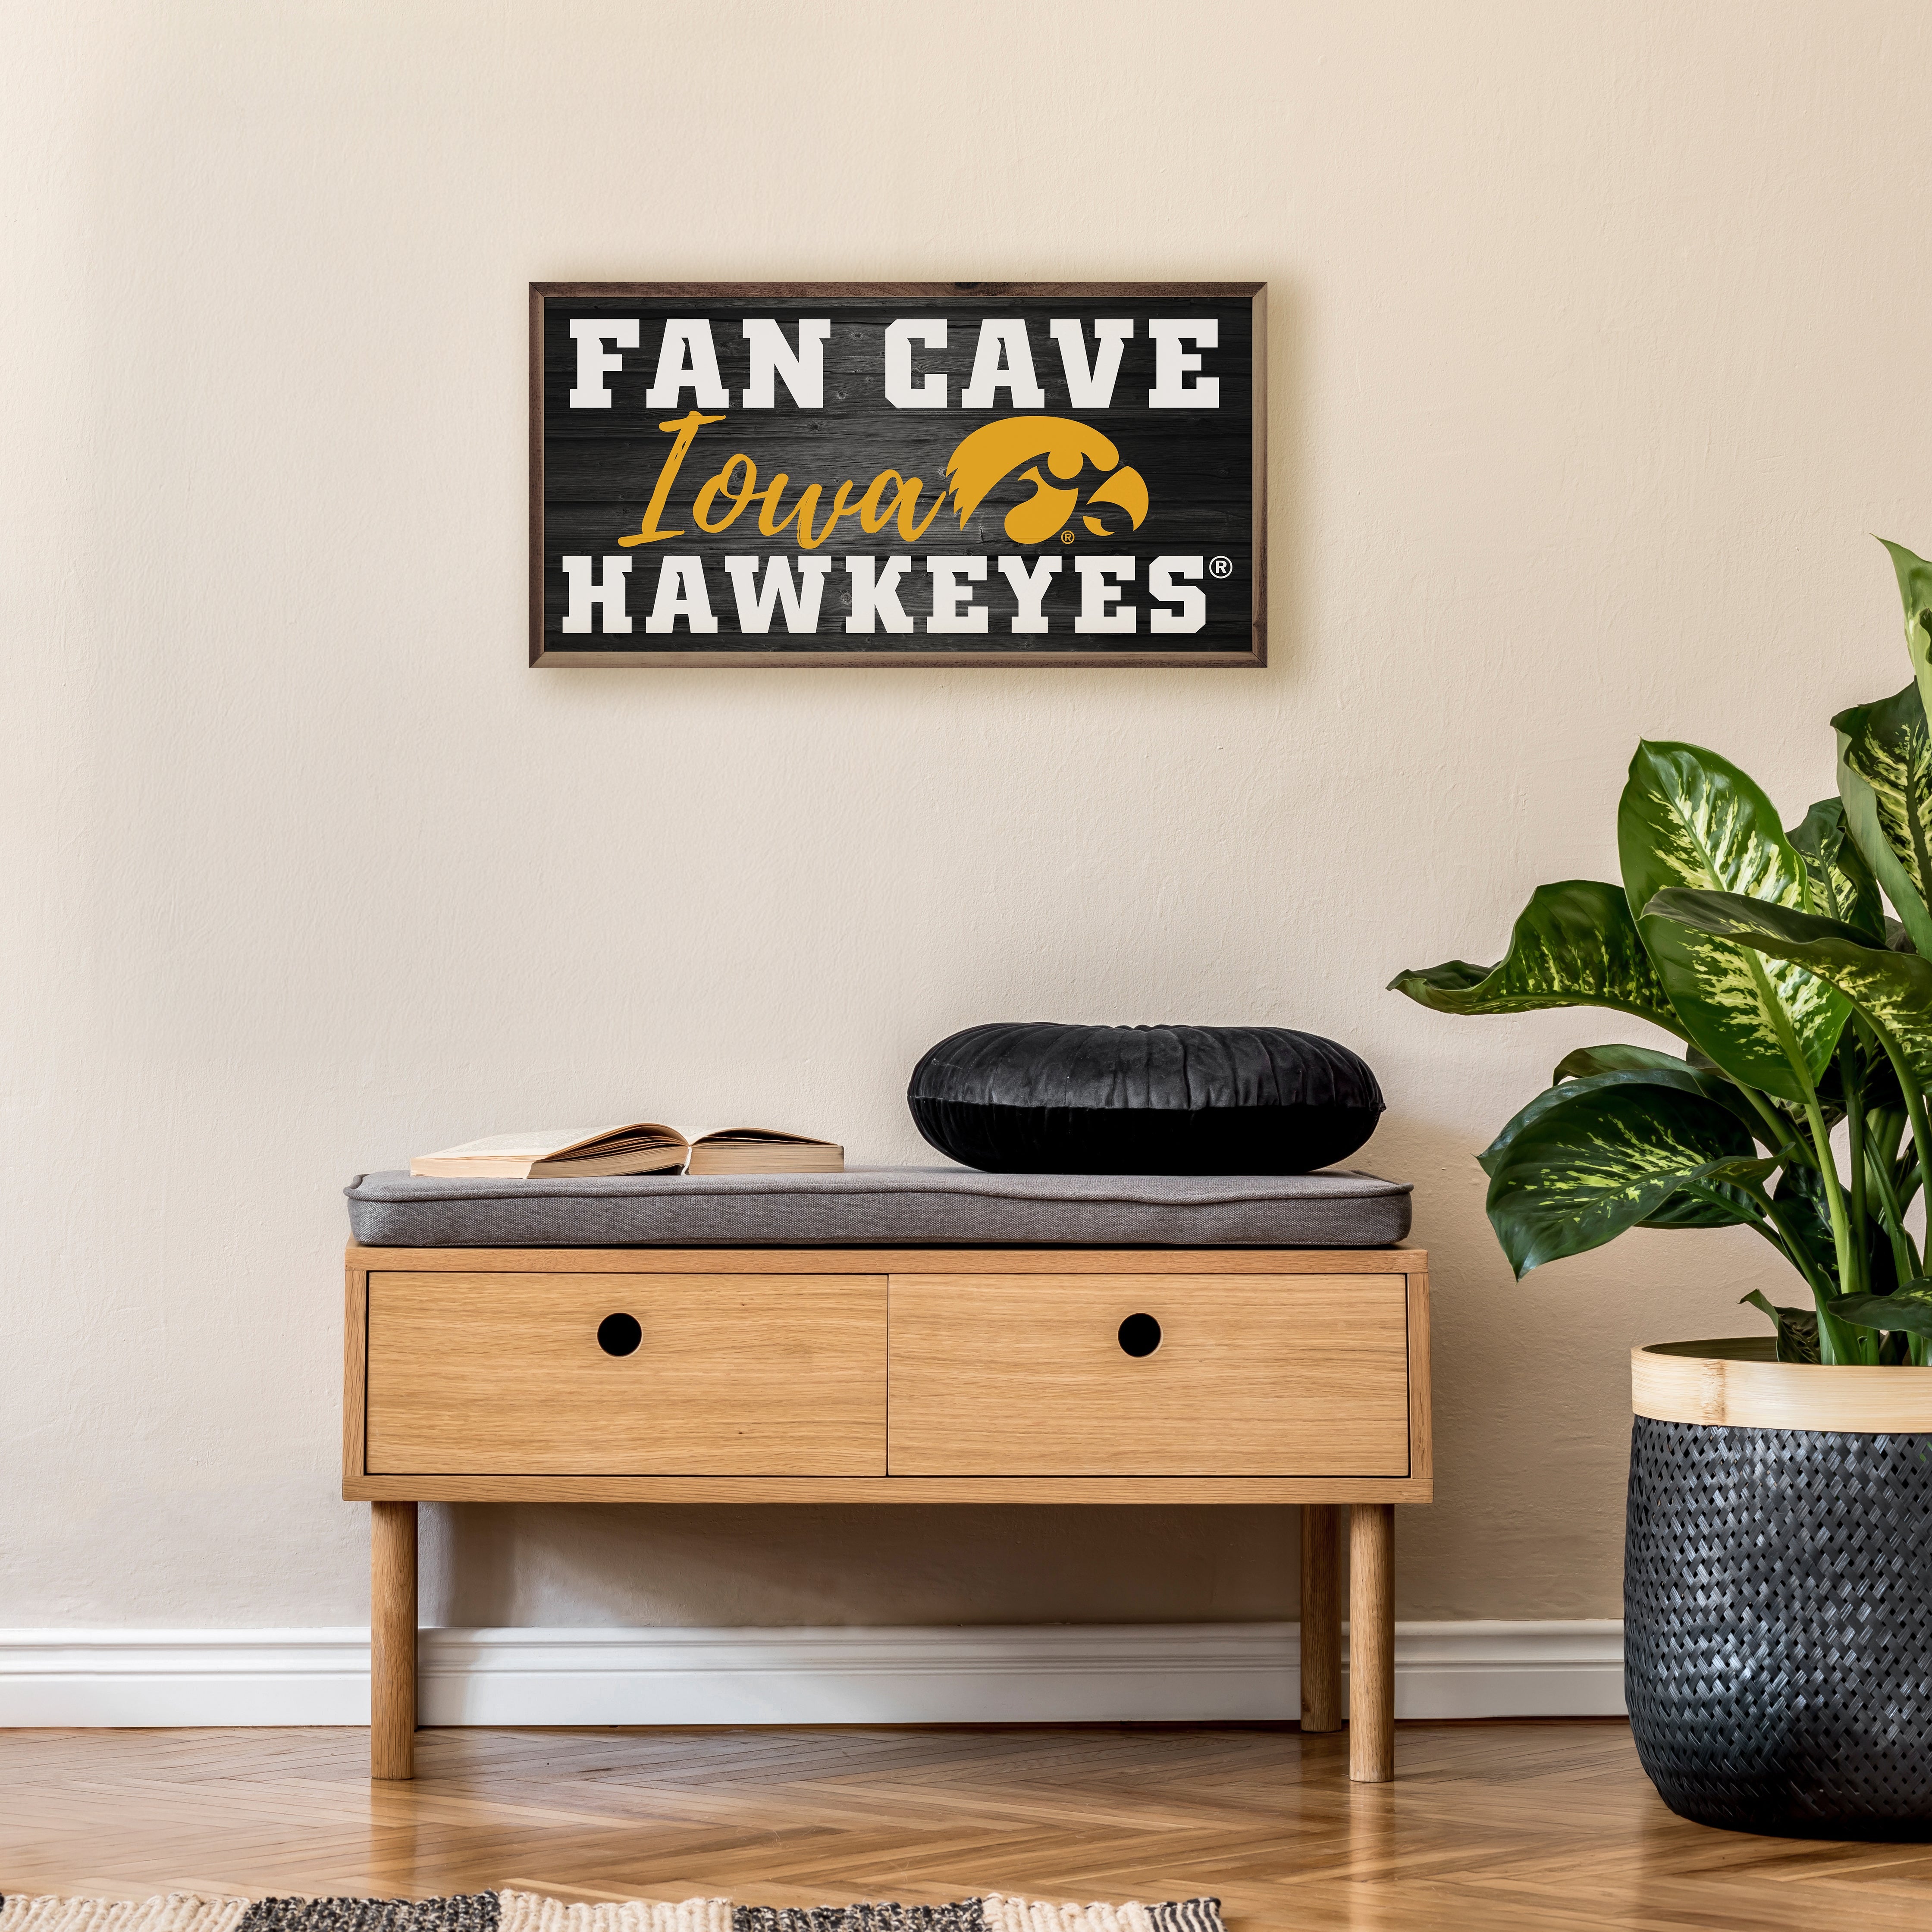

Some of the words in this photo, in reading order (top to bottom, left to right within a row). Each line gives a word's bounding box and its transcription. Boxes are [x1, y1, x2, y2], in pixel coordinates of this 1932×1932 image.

[570, 319, 831, 408] FAN
[885, 319, 1220, 408] CAVE
[618, 411, 947, 549] Iowa
